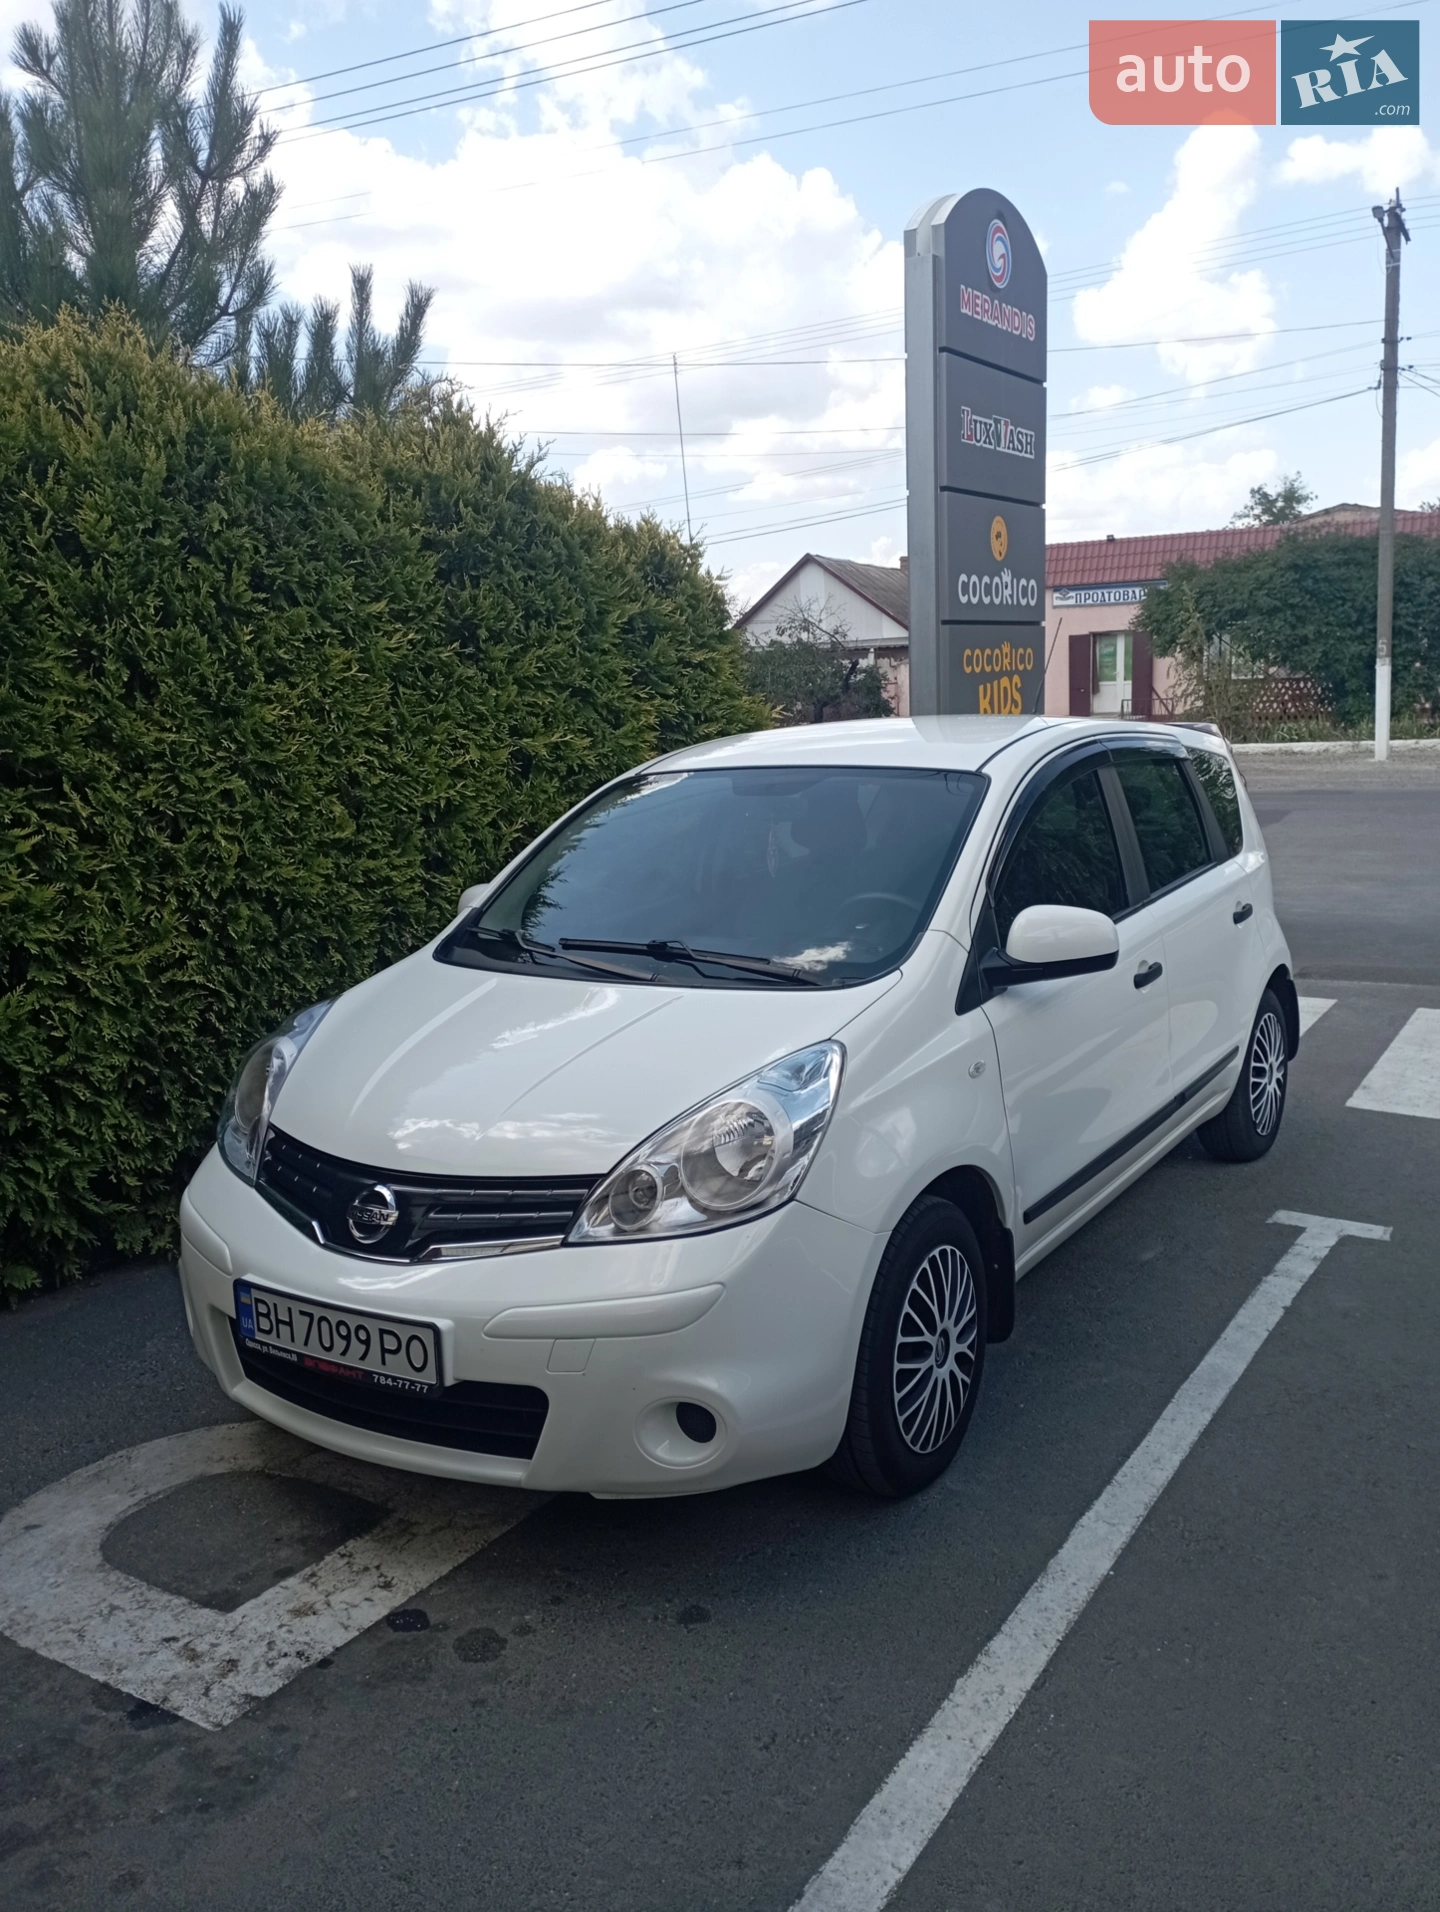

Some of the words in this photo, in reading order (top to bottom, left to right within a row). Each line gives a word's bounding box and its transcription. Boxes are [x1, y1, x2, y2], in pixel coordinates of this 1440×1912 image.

[960, 285, 1035, 341] MERANDIS
[958, 568, 1038, 606] COCORICO
[1075, 589, 1148, 604] ПРОДТОВАР
[963, 641, 1034, 674] COCORICO
[979, 674, 1023, 716] KIDS
[242, 1317, 254, 1329] UA
[372, 1373, 429, 1393] 784-77-77
